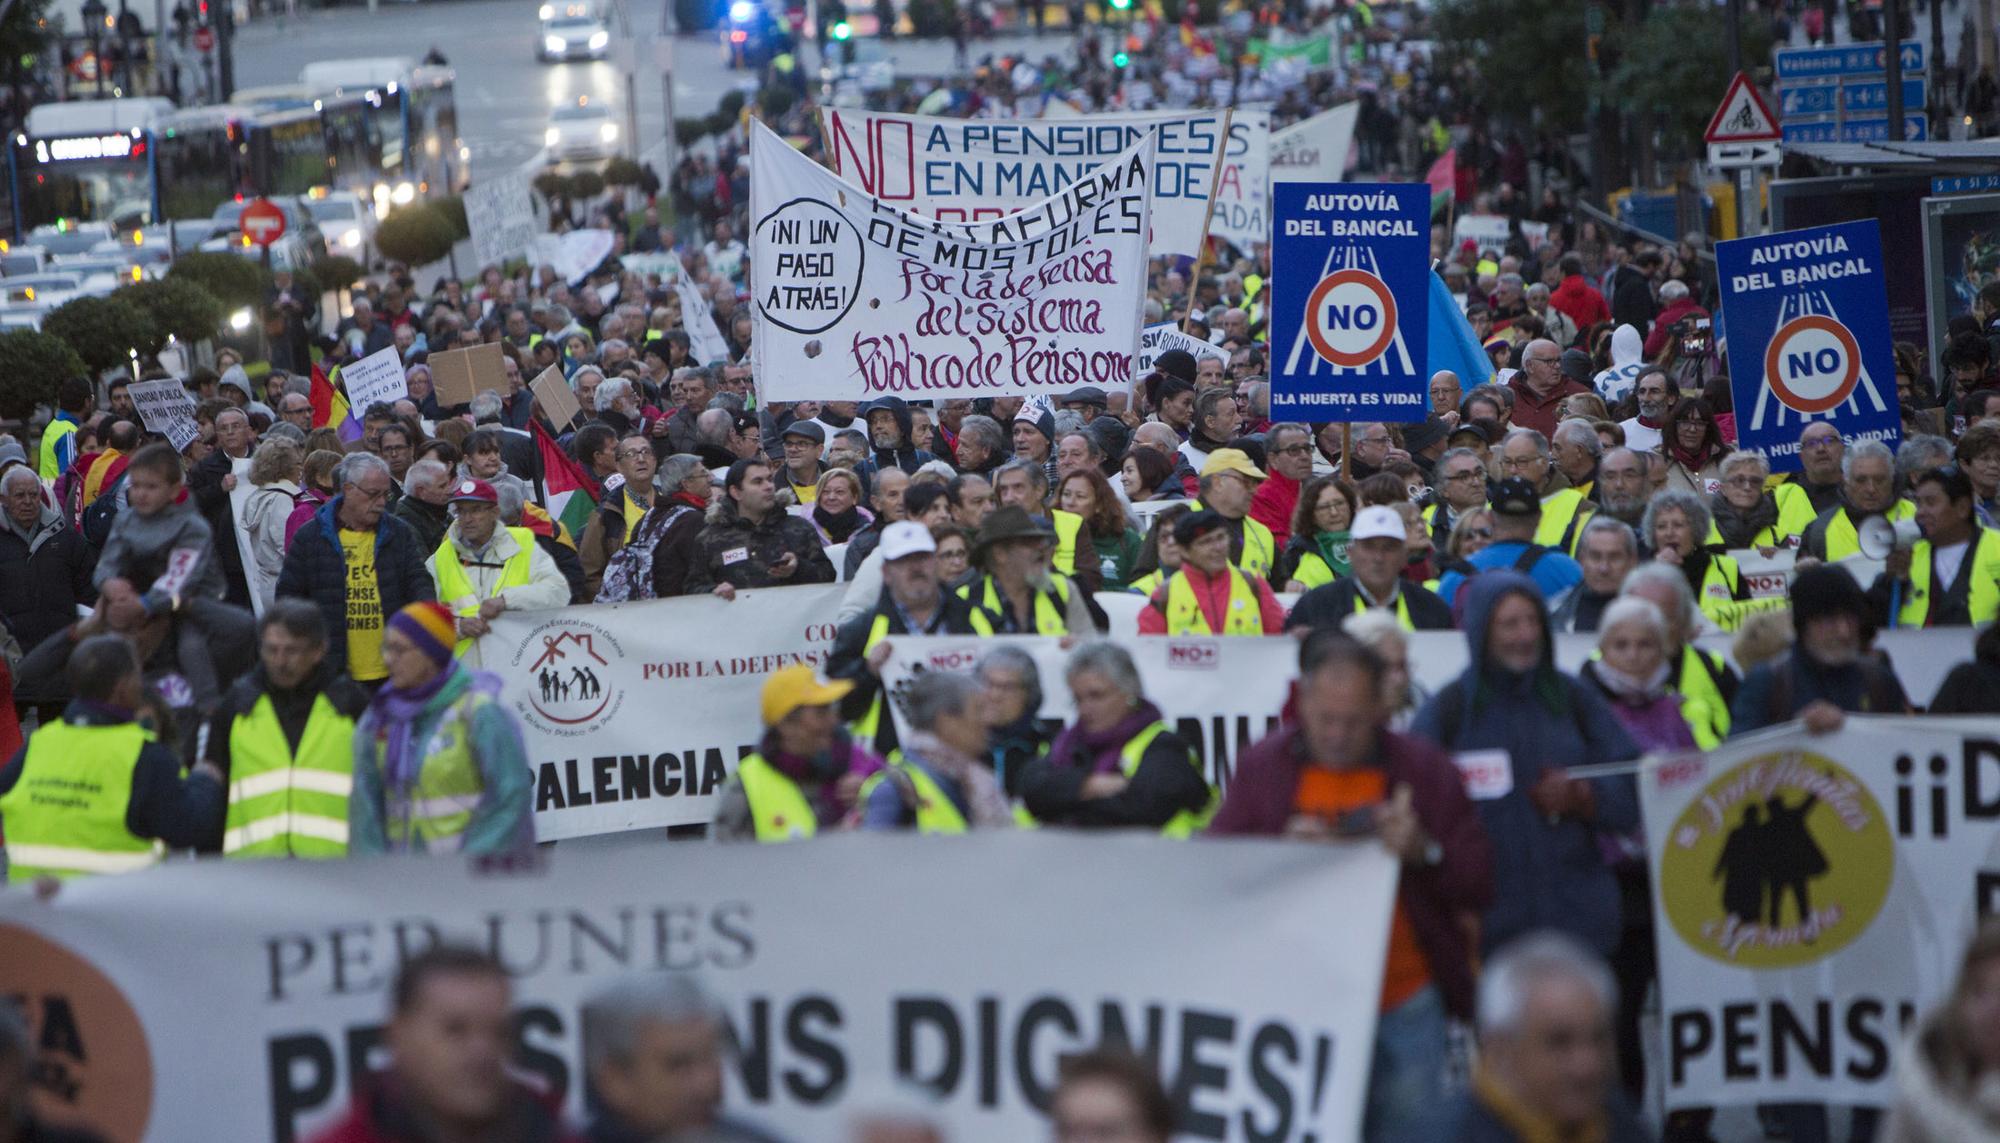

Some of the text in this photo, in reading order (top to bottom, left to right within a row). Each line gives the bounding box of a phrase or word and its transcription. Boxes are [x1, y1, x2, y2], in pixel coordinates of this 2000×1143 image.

[832, 110, 1216, 200] NO A PENSIONES
[926, 161, 984, 197] EN
[1155, 163, 1211, 199] DE
[1305, 191, 1400, 211] AUTOVÍA
[810, 220, 840, 244] UN
[867, 218, 925, 260] DE
[1285, 219, 1419, 237] DEL BANCAL
[1750, 232, 1849, 265] AUTOVÍA
[776, 252, 834, 278] PASO
[1732, 258, 1872, 293] DEL BANCAL
[766, 281, 846, 310] ATRÁS!
[898, 258, 955, 303] Por
[916, 292, 971, 336] del
[1327, 304, 1378, 331] NO
[1787, 348, 1841, 379] NO
[1273, 393, 1422, 405] ¡LA HUERTA ES VIDA!
[1770, 442, 1802, 457] HUE
[1747, 577, 1784, 590] NO+
[512, 619, 625, 667] Coordinadora Estatal por la Defensa
[804, 623, 837, 642] CO
[642, 661, 690, 680] POR
[696, 659, 725, 678] LA
[554, 728, 585, 737] Público
[530, 747, 727, 812] ALENCIA
[484, 902, 757, 978] UNES
[1670, 998, 1916, 1088] PENS
